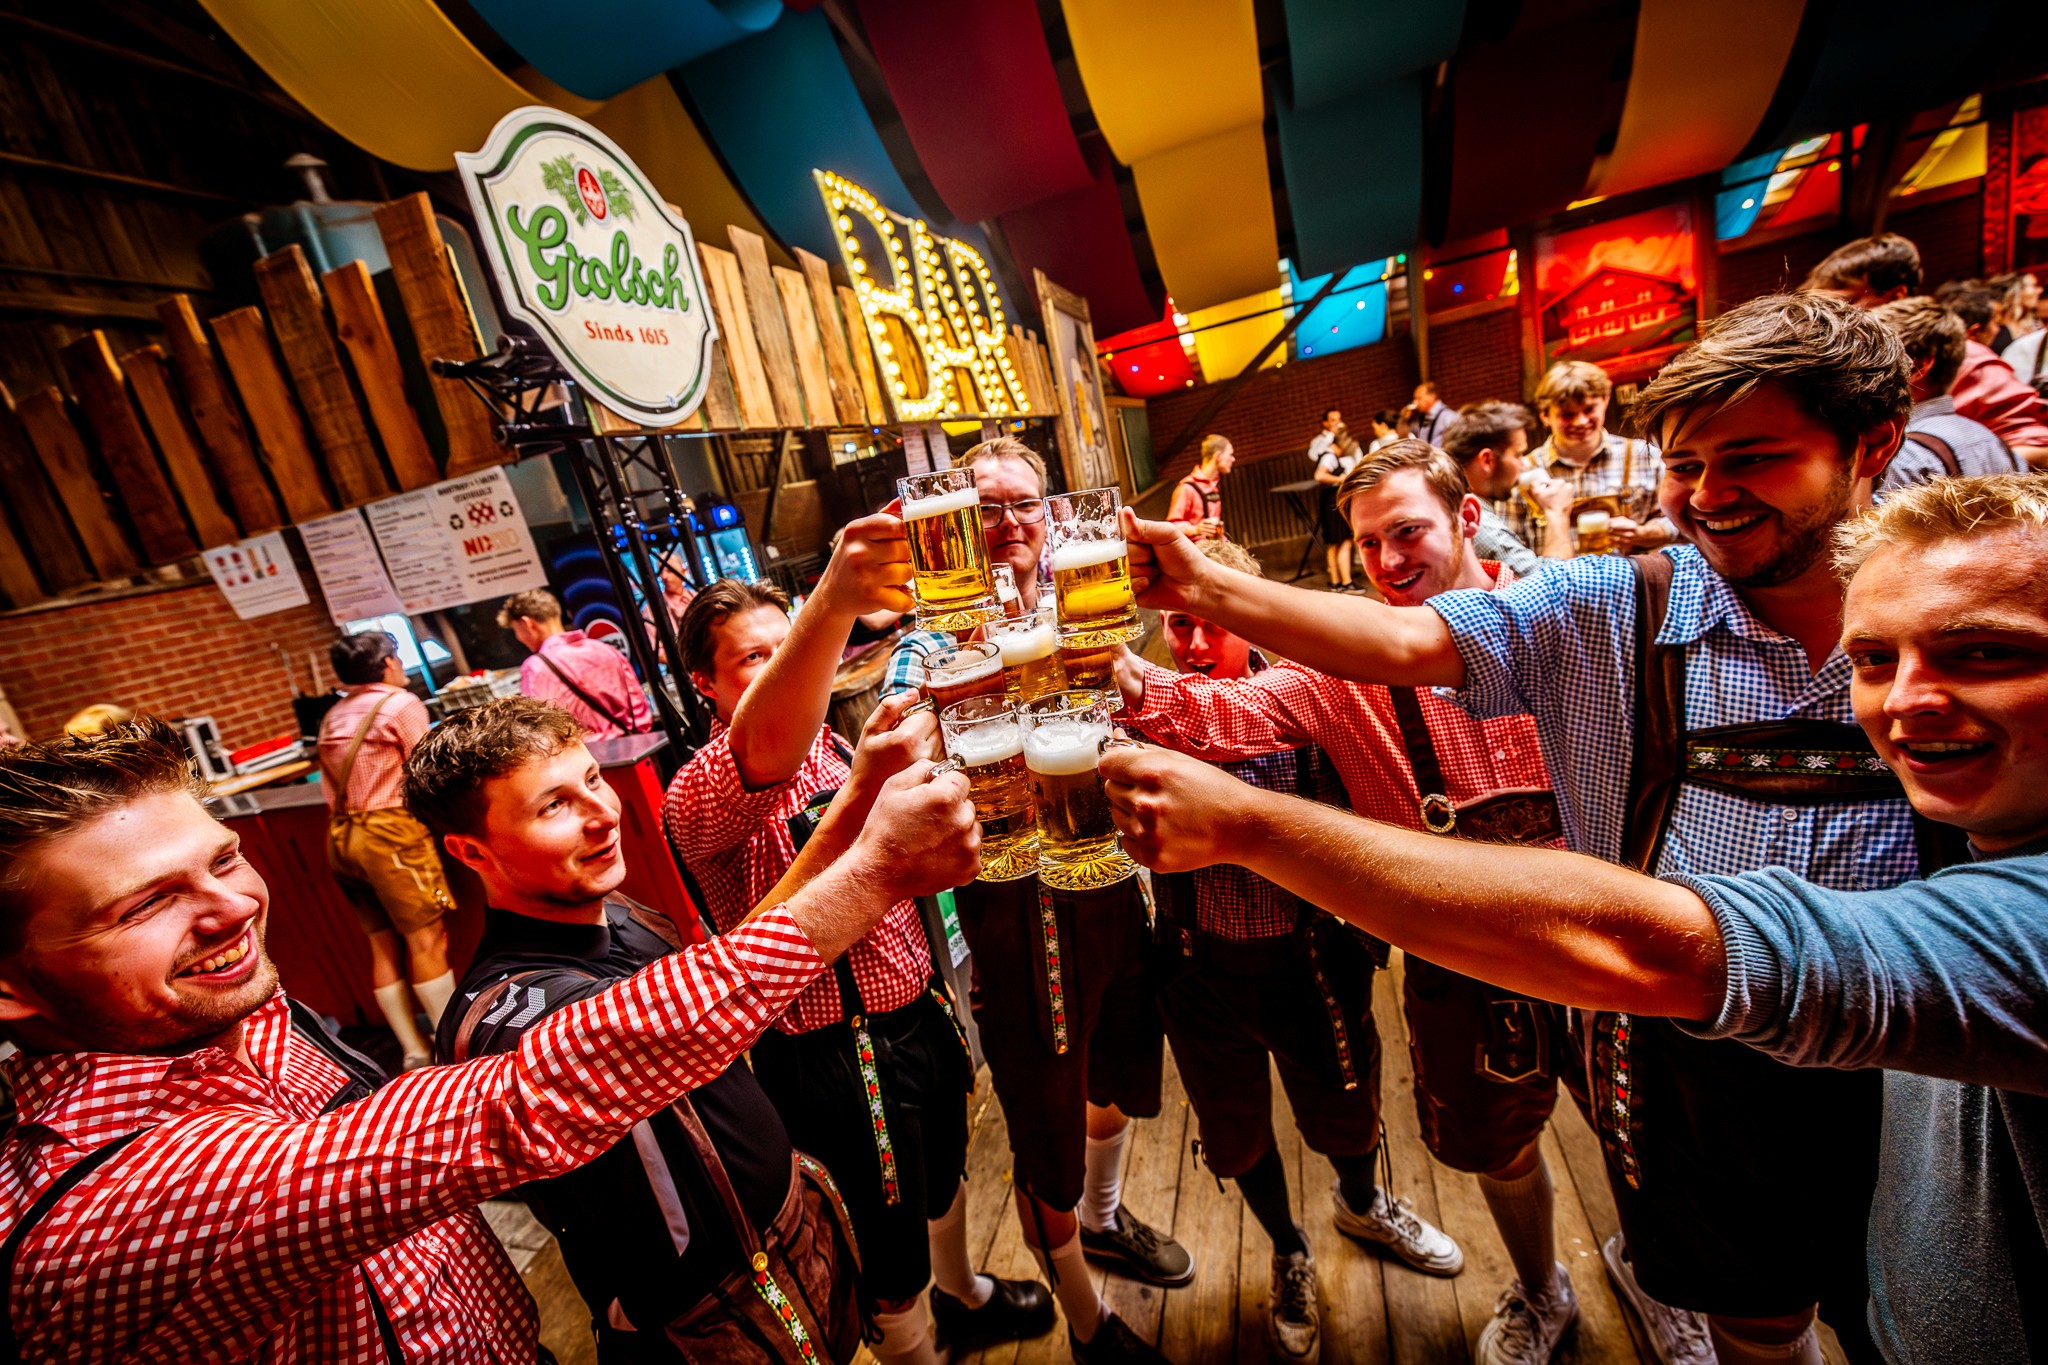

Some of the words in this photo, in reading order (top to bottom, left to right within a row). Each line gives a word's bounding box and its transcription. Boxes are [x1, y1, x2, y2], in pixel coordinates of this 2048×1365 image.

[507, 204, 690, 312] Grolsch
[813, 168, 1031, 421] BAR
[584, 320, 634, 342] Sinds
[639, 327, 669, 346] 1615
